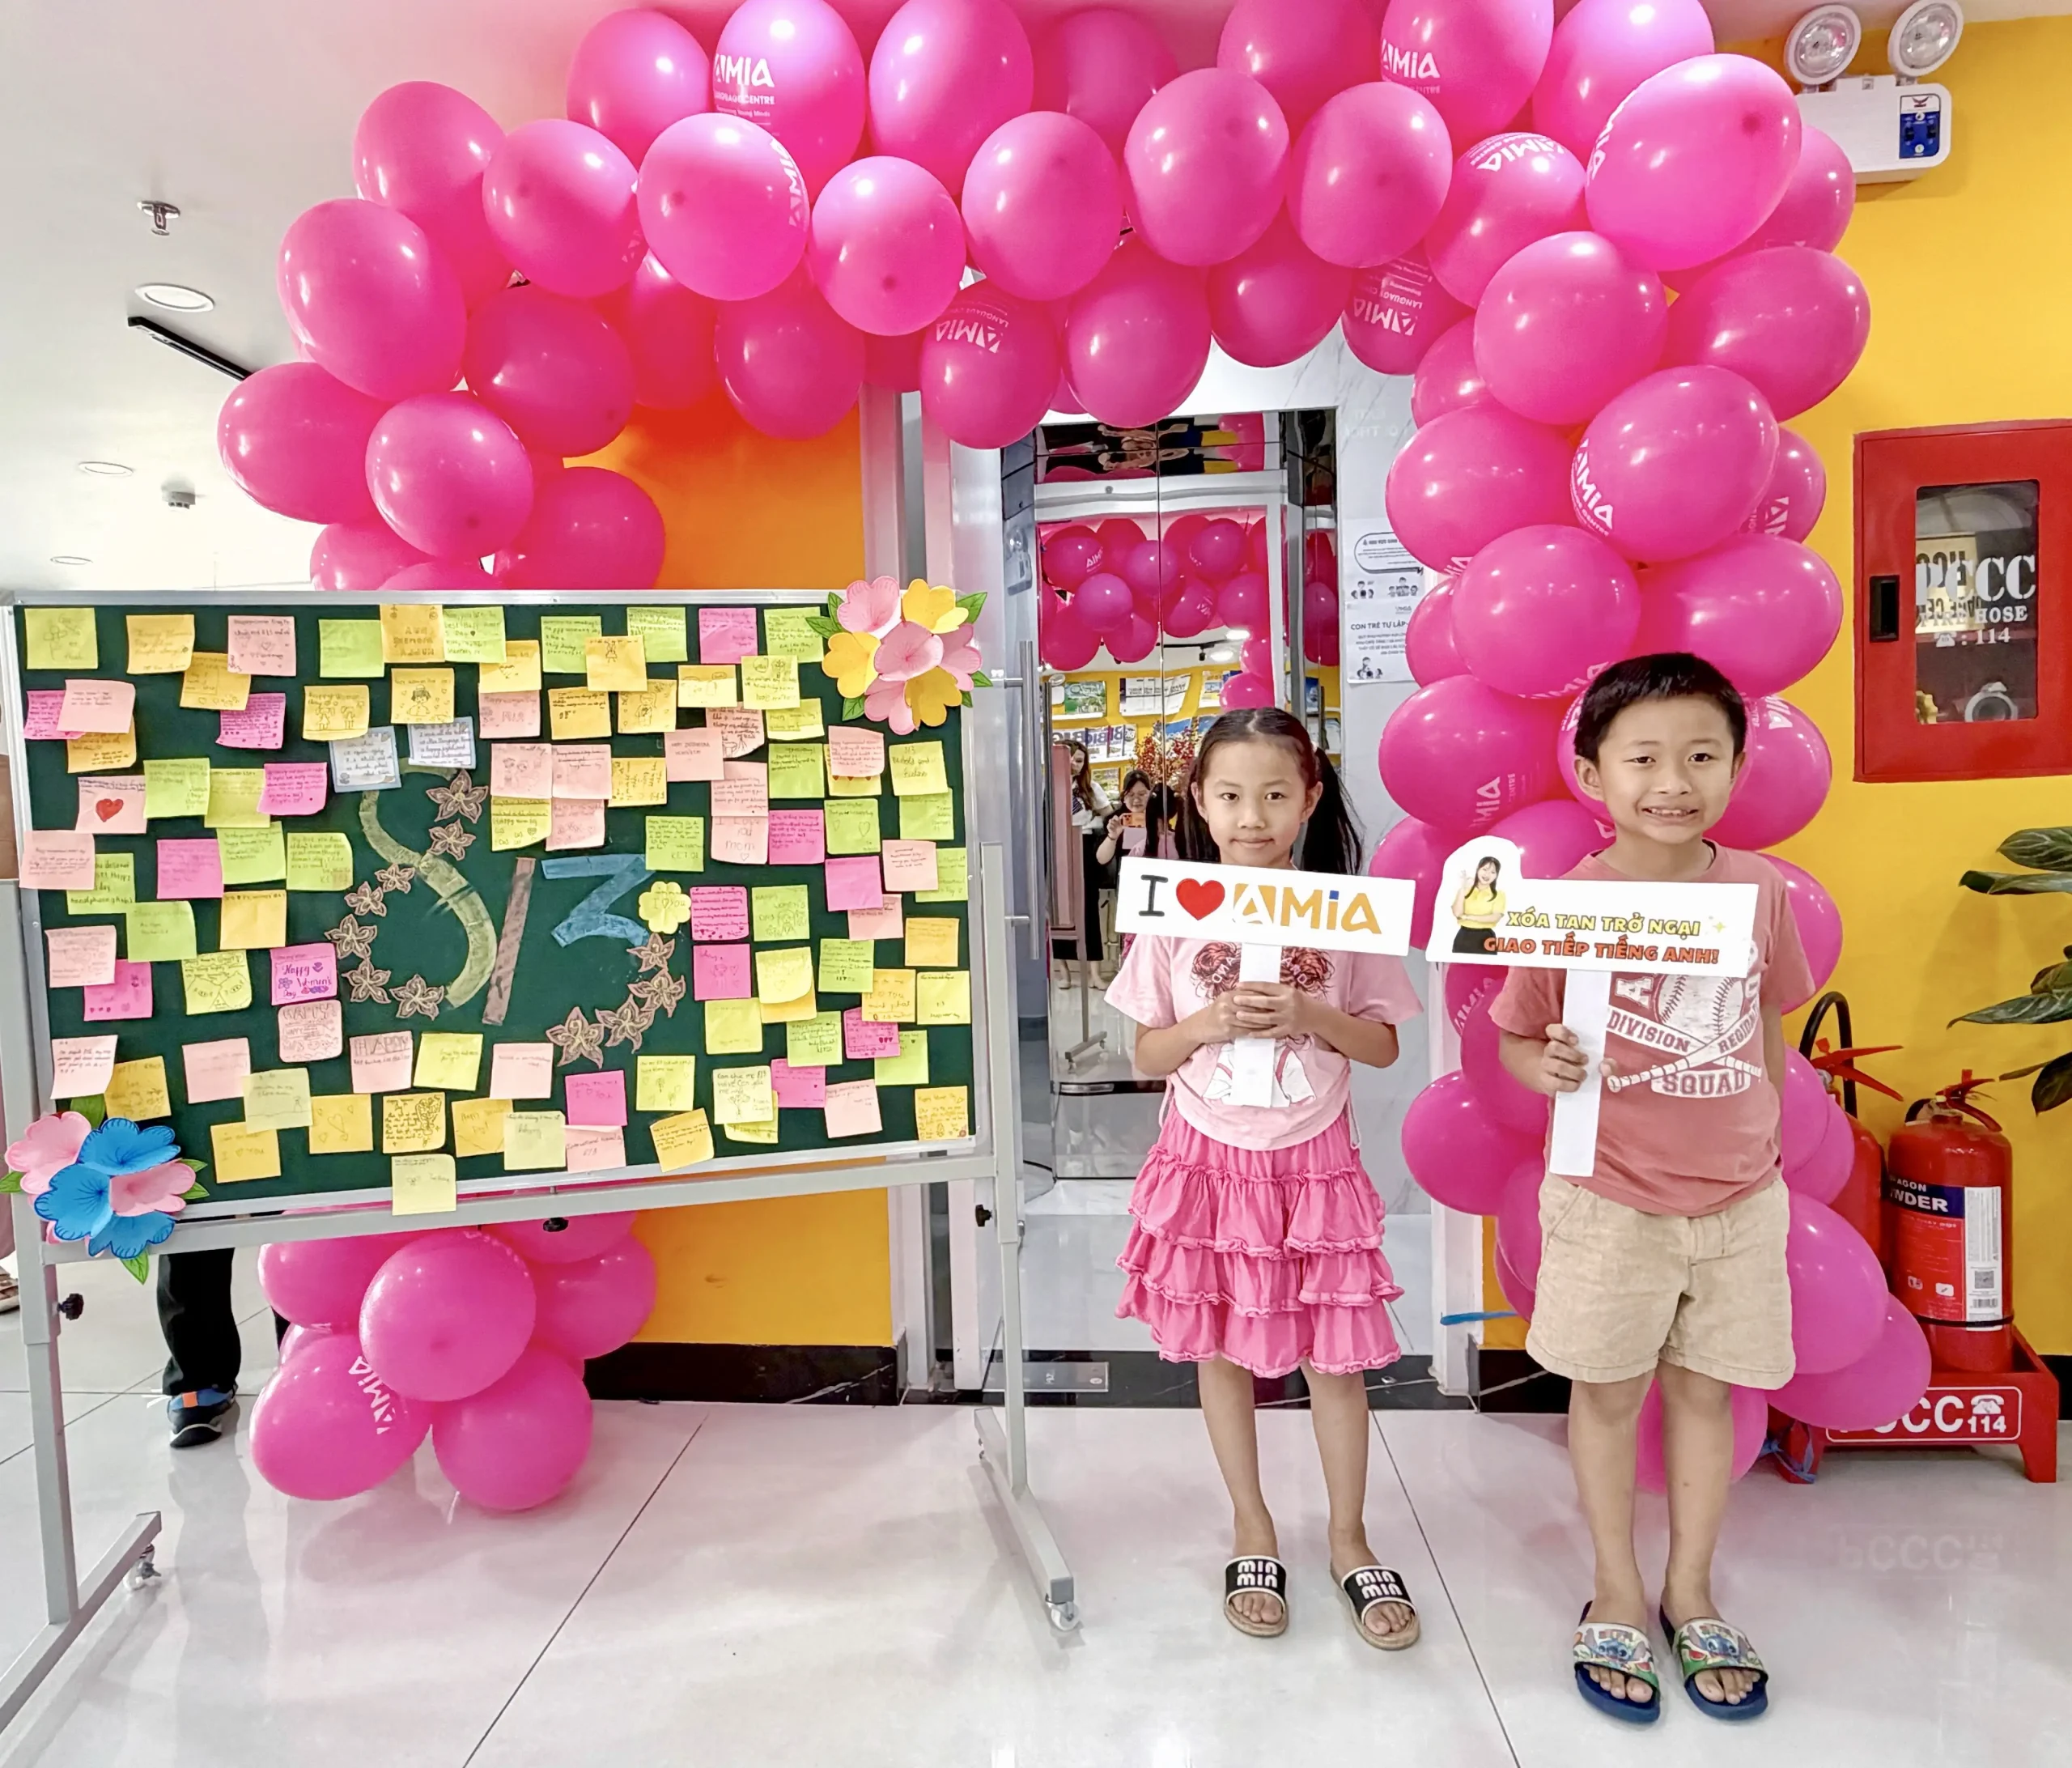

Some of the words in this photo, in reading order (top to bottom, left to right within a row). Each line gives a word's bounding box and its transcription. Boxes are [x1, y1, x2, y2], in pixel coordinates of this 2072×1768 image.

[714, 53, 775, 87] AMIA
[1381, 38, 1441, 79] AMIA
[1353, 295, 1417, 336] AMIA
[1916, 555, 2036, 606] PCCC
[1975, 606, 2028, 623] HOSE
[1976, 627, 2010, 645] 114
[1138, 874, 1169, 917] I
[1233, 882, 1382, 935] AMiA
[1505, 906, 1550, 929] XÓA
[1555, 914, 1596, 931] TAN
[1602, 912, 1645, 933] TRỞ
[1648, 919, 1700, 940] NGẠI
[1484, 937, 1536, 954] GIAO
[1542, 931, 1590, 958] TIẾP
[1594, 934, 1658, 962] TIẾNG
[1662, 946, 1720, 964] ANH!
[282, 963, 310, 976] Happy
[1607, 1011, 1691, 1053] DIVISION
[1662, 1073, 1745, 1095] SQUAD
[1890, 1177, 1927, 1192] AGON
[1891, 1188, 1949, 1213] WDER
[1968, 1416, 2007, 1433] 114
